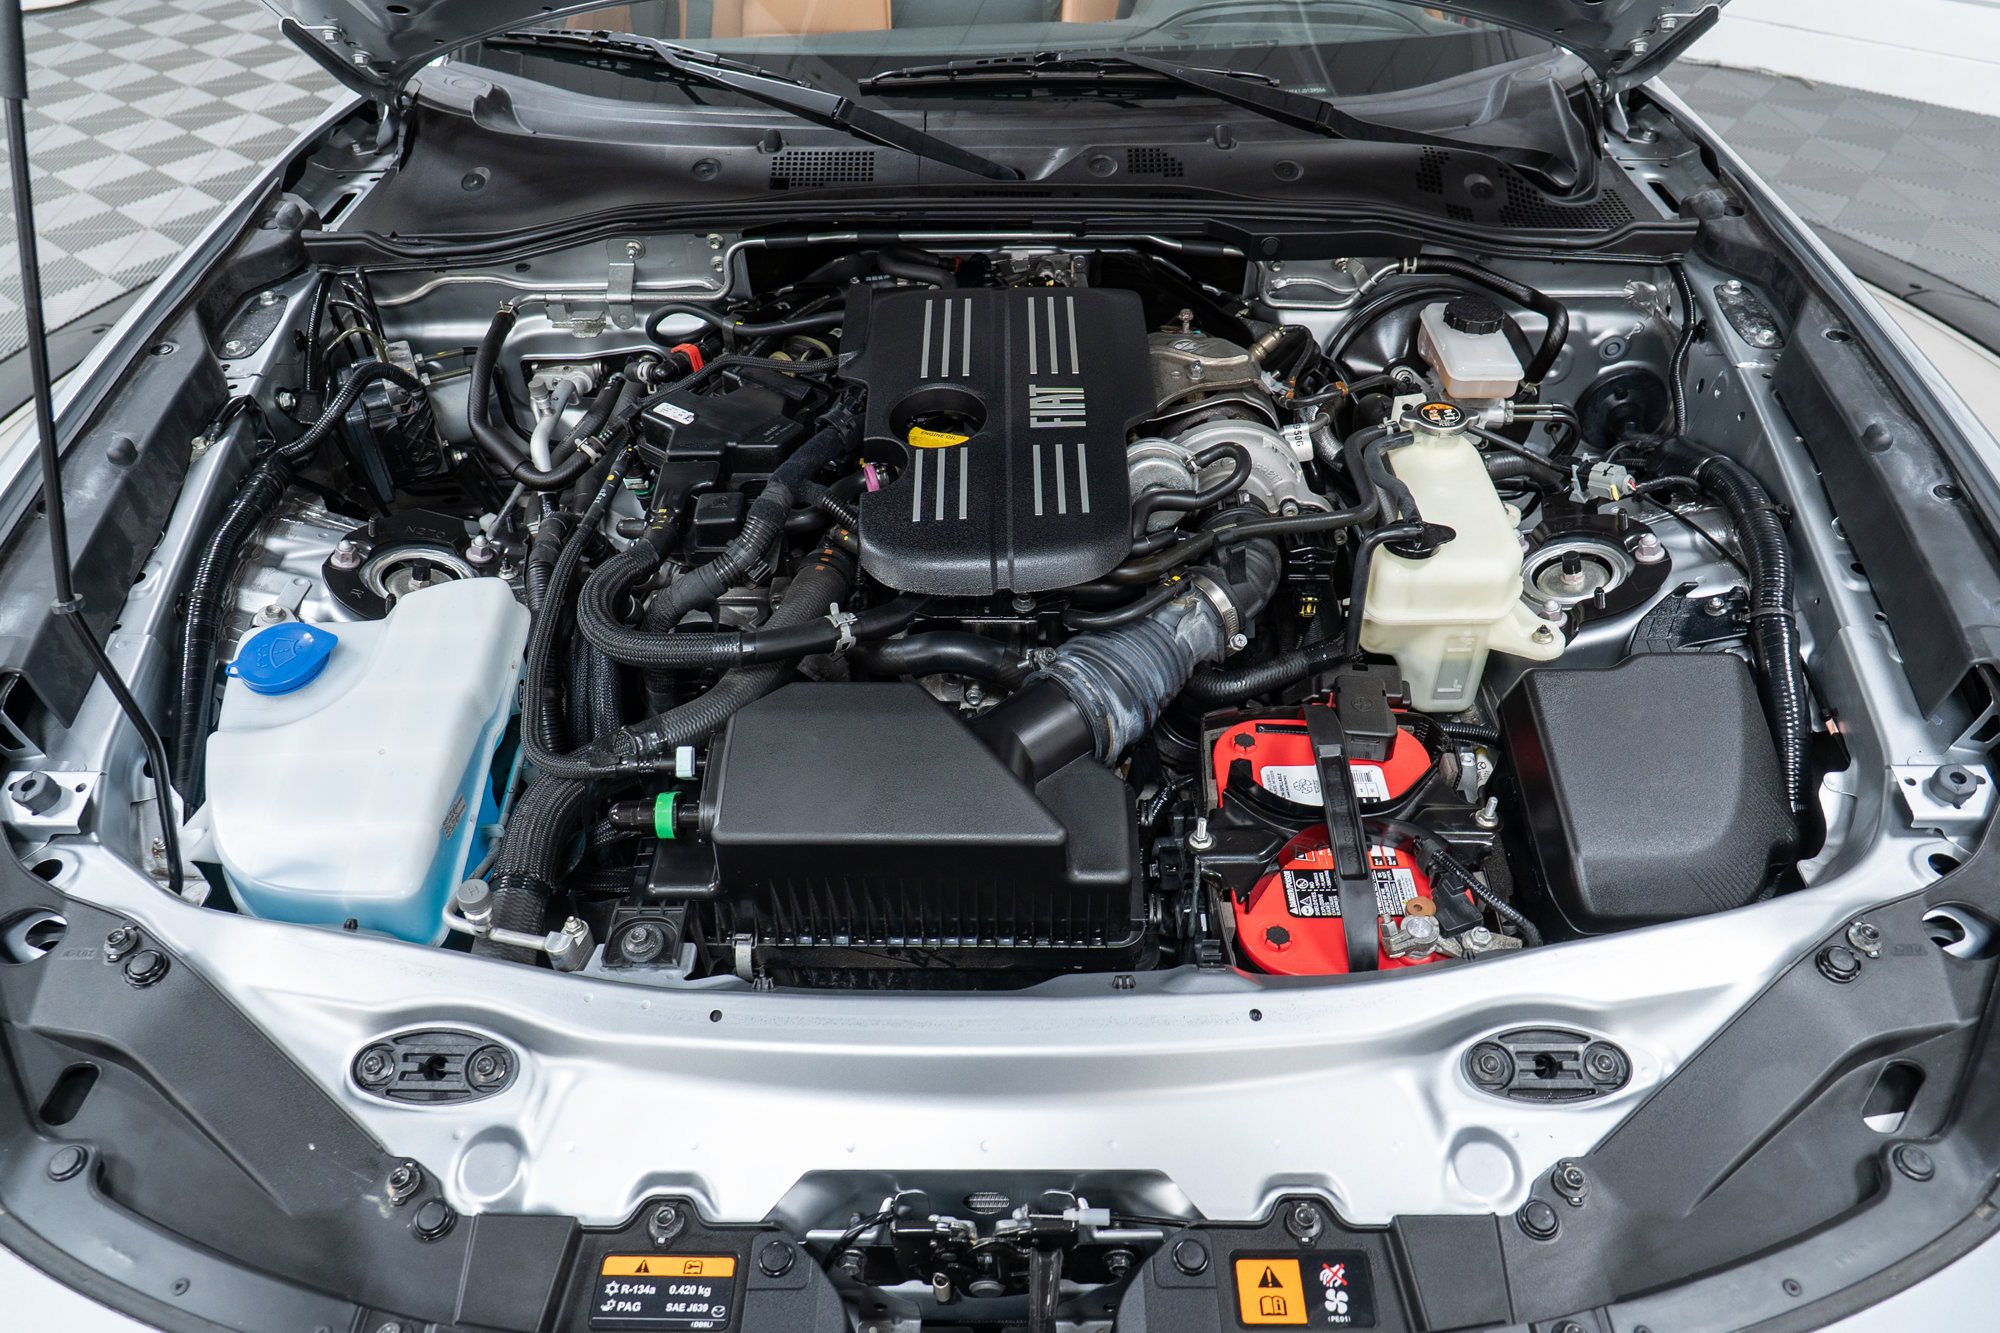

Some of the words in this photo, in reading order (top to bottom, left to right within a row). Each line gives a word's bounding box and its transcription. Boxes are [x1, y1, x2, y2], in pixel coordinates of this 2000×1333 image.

[1029, 383, 1087, 428] FIAT
[920, 430, 945, 439] ENGINE
[620, 1284, 656, 1295] R-134a
[668, 1284, 696, 1295] 0.420
[697, 1285, 712, 1297] kg
[616, 1301, 642, 1312] PAG
[665, 1303, 686, 1312] SAE
[687, 1303, 709, 1312] J639
